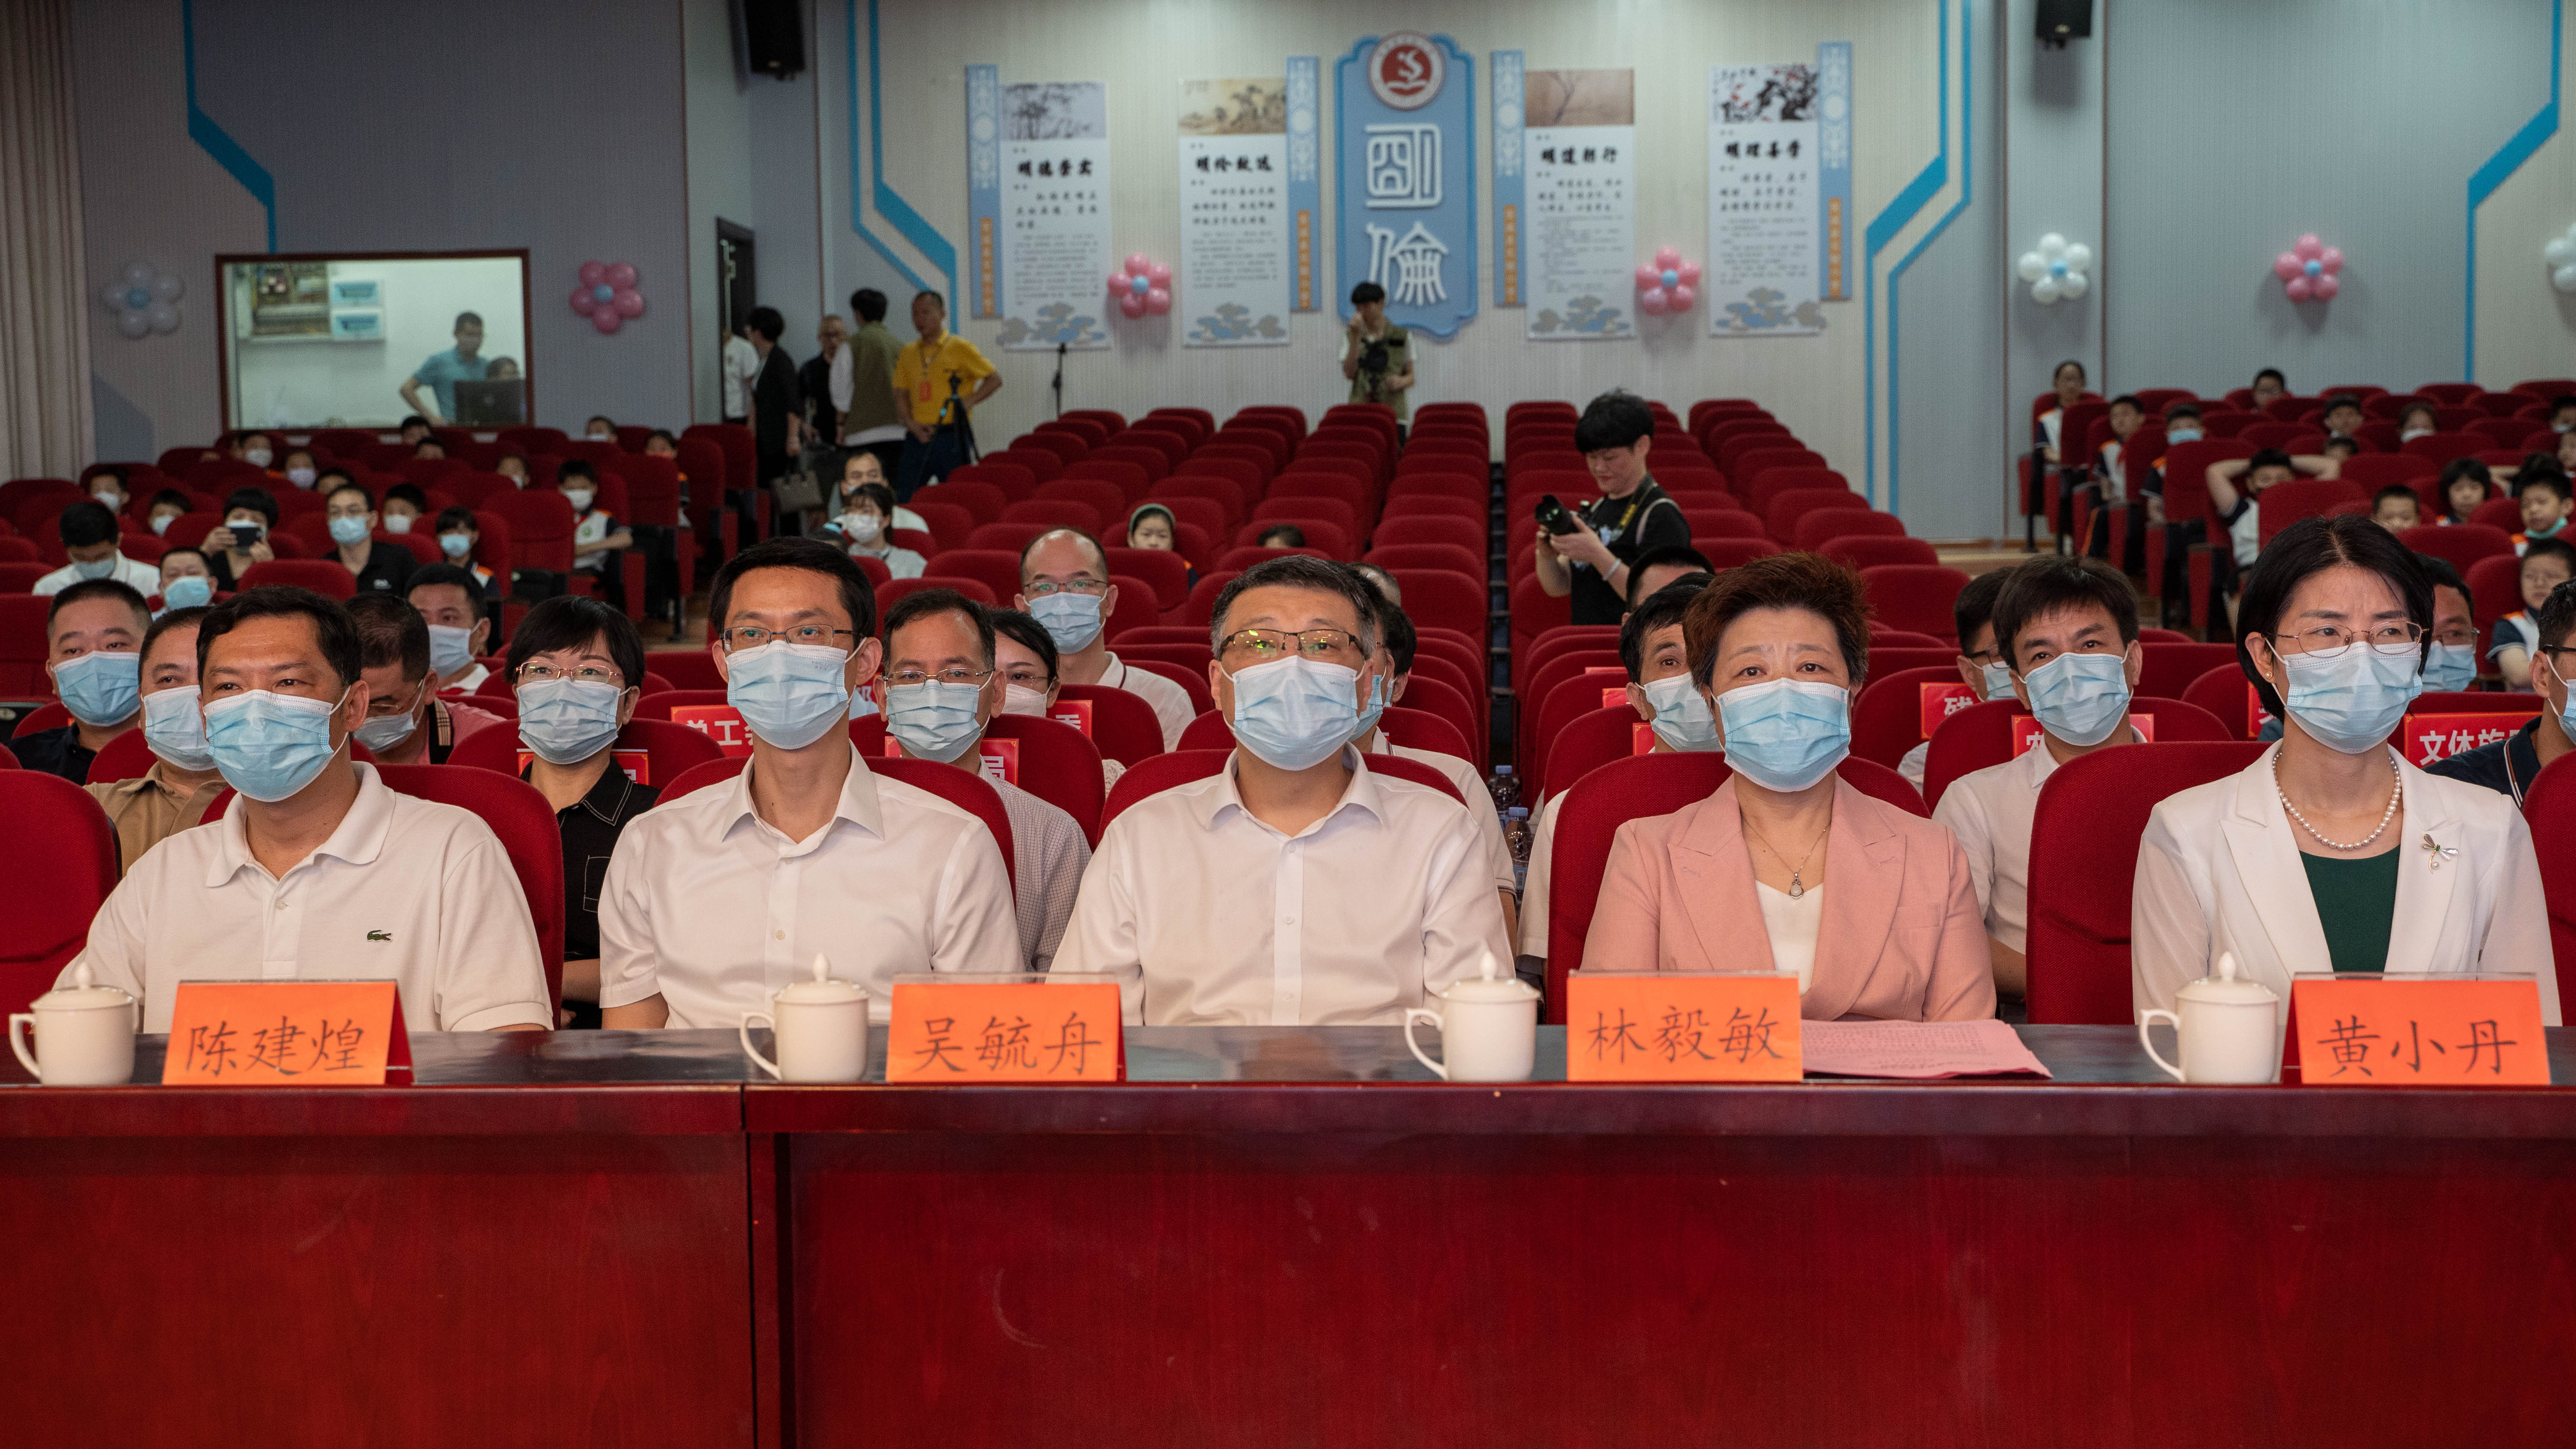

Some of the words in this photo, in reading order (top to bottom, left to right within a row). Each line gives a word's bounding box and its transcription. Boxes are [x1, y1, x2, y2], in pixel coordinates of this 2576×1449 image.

[186, 1016, 365, 1077] 陈建煌
[914, 1012, 1102, 1076] 吴毓舟
[1586, 1005, 1783, 1063] 林毅敏
[2317, 1015, 2517, 1077] 黄小丹
